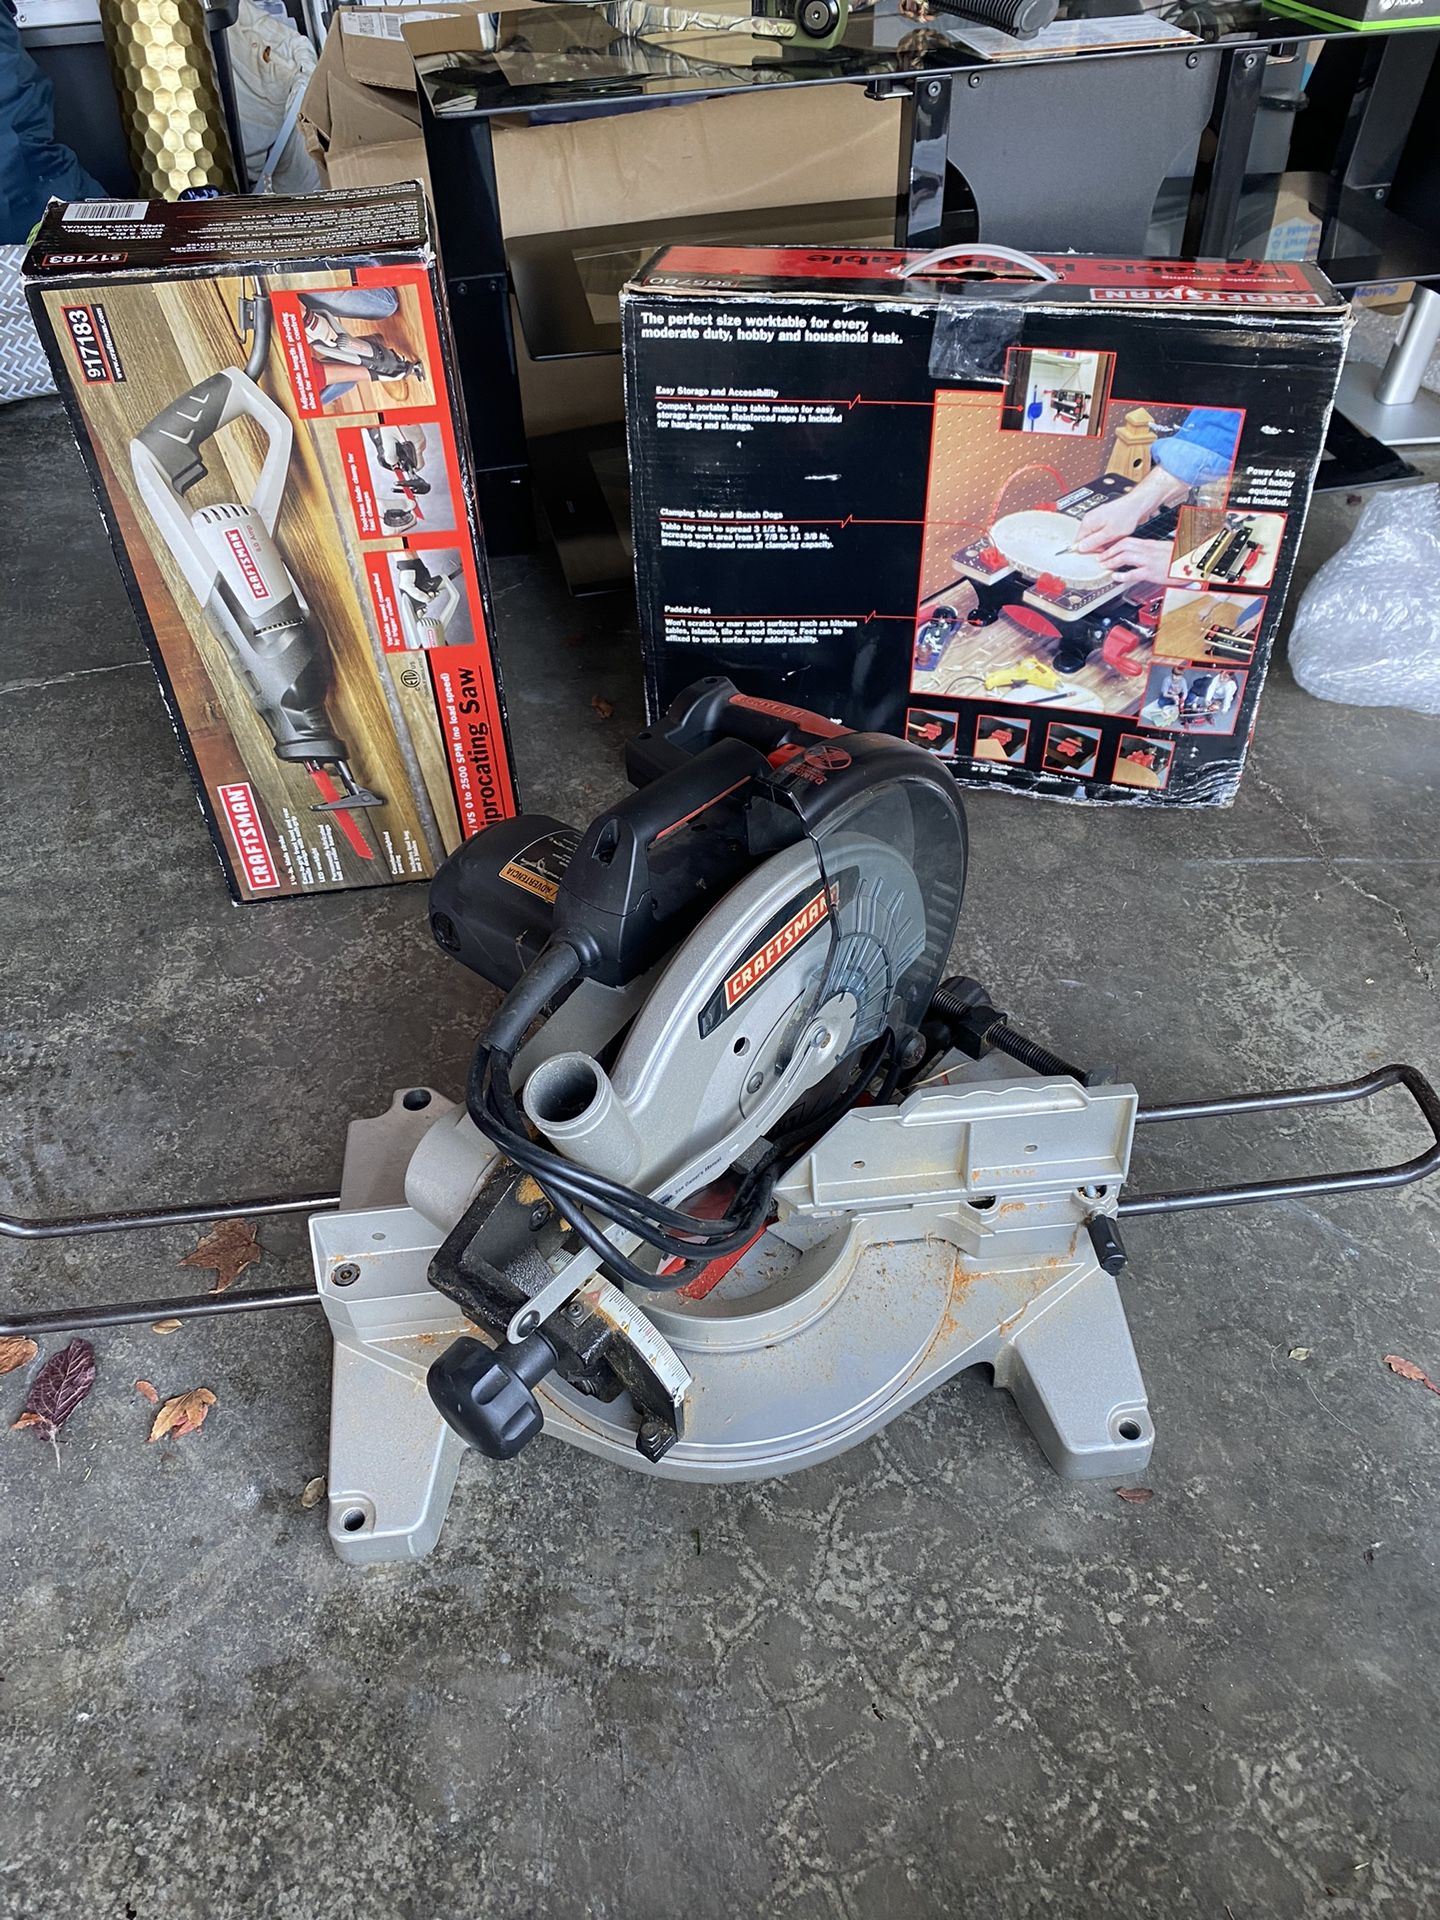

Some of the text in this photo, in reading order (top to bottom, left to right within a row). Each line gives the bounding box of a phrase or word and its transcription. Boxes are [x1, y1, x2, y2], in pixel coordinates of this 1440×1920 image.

[48, 255, 120, 263] 917183
[1097, 264, 1289, 279] Portable
[1104, 290, 1310, 303] CRAFTSMAN
[640, 312, 868, 331] The perfect size worktable for every
[641, 326, 903, 344] moderate duty, hobby and household task.
[69, 309, 108, 378] 917183
[96, 307, 124, 379] www.craftsman.com
[282, 311, 310, 410] Adjustable length pivoting
[290, 313, 317, 409] shoe for maximum control
[656, 386, 778, 398] Easy Storage and Accessibility
[656, 402, 694, 412] Compact,
[696, 404, 729, 413] portable
[731, 404, 748, 412] size
[750, 404, 770, 413] table
[772, 405, 799, 413] makes
[816, 407, 835, 415] easy
[657, 412, 842, 424] storage anywhere. Reinforced rope is included
[657, 420, 754, 431] for hanging and storage.
[350, 463, 361, 484] clamp
[1246, 466, 1296, 478] Power tools
[1251, 477, 1294, 488] and hobby
[355, 484, 364, 502] blade
[1248, 487, 1292, 497] equipment
[1236, 496, 1289, 506] not included.
[359, 503, 370, 531] Tool-less
[364, 490, 377, 531] fast changes
[660, 508, 696, 518] Clamping
[697, 510, 717, 518] Table
[736, 511, 760, 519] Bench
[763, 512, 783, 520] Dogs
[661, 522, 681, 531] Table
[683, 524, 696, 532] top
[713, 524, 723, 532] be
[725, 525, 751, 533] spread
[661, 531, 692, 539] increase
[695, 532, 714, 540] work
[716, 533, 733, 541] area
[735, 533, 753, 541] from
[780, 533, 788, 541] to
[661, 539, 834, 550] Bench dogs expand overall clamping capacity.
[230, 532, 266, 596] CRAFTSMAN
[374, 572, 394, 646] Variable speed controlled
[664, 605, 711, 614] Padded Feet
[386, 596, 401, 645] by trigger switch
[688, 620, 714, 628] scratch
[746, 620, 765, 628] work
[767, 620, 798, 628] surfaces
[830, 620, 857, 628] kitchen
[665, 627, 689, 636] tables,
[691, 627, 719, 636] islands,
[721, 628, 733, 636] tile
[745, 628, 765, 636] wood
[767, 628, 797, 637] flooring.
[799, 628, 816, 636] Feet
[665, 635, 690, 643] affixed
[441, 672, 455, 703] speed)
[448, 705, 458, 724] load
[451, 725, 462, 740] (no
[454, 666, 503, 825] iprocating Saw
[455, 742, 466, 763] SPM
[460, 765, 471, 789] 2500
[465, 791, 473, 800] to
[468, 811, 477, 823] VS
[228, 788, 273, 884] CRAFTSMAN
[507, 867, 552, 894] ADVERTENCIA
[674, 1157, 722, 1194] See Owner's Manual
